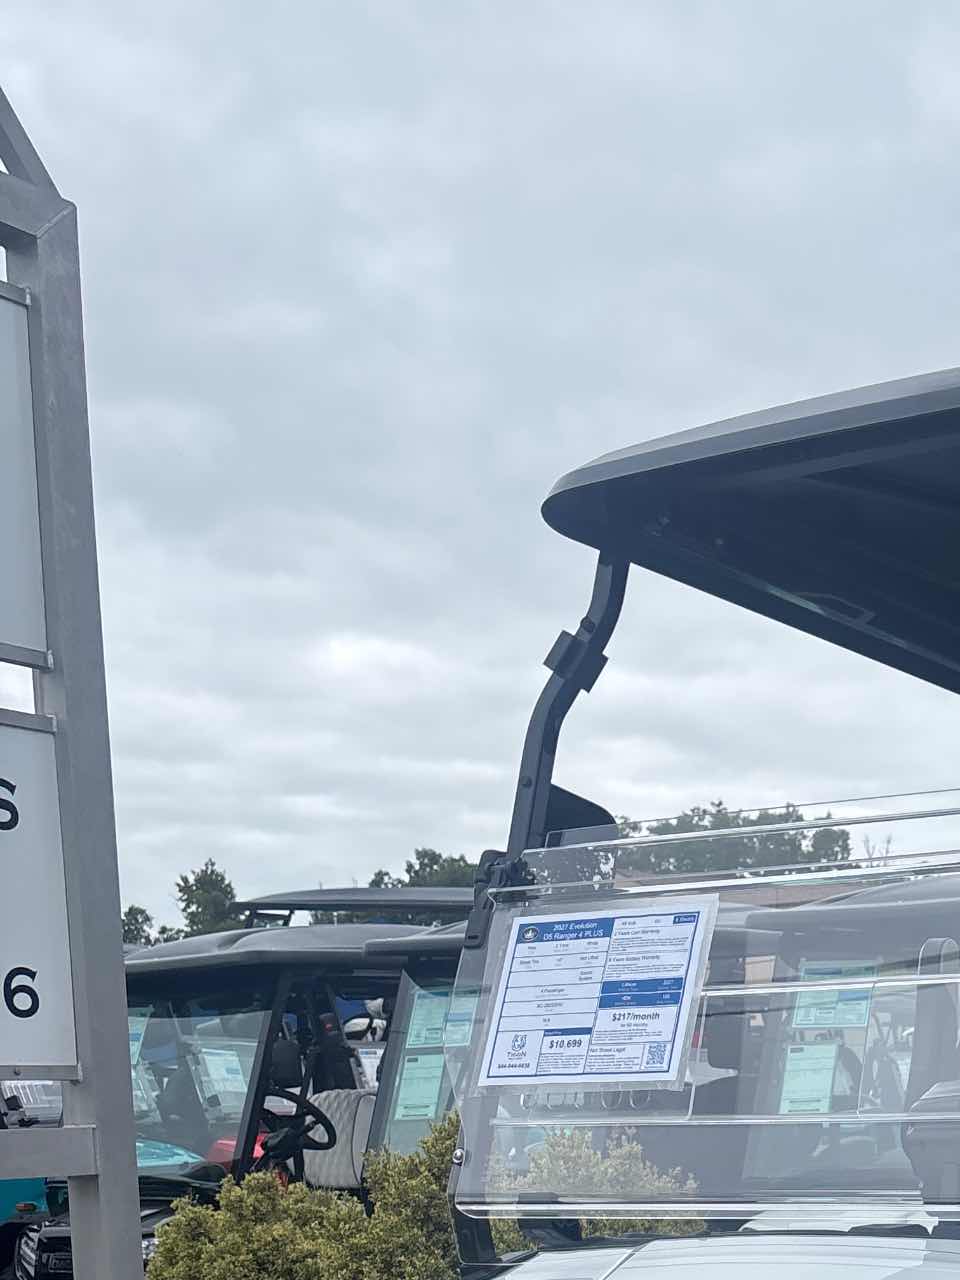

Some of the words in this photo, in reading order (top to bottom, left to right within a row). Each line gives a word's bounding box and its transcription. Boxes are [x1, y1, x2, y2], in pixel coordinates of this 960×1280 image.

[569, 922, 598, 930] Evolution
[554, 932, 578, 941] Ranger
[584, 929, 604, 938] PLUS
[3, 966, 40, 1018] 6
[612, 1011, 660, 1022] $217/month
